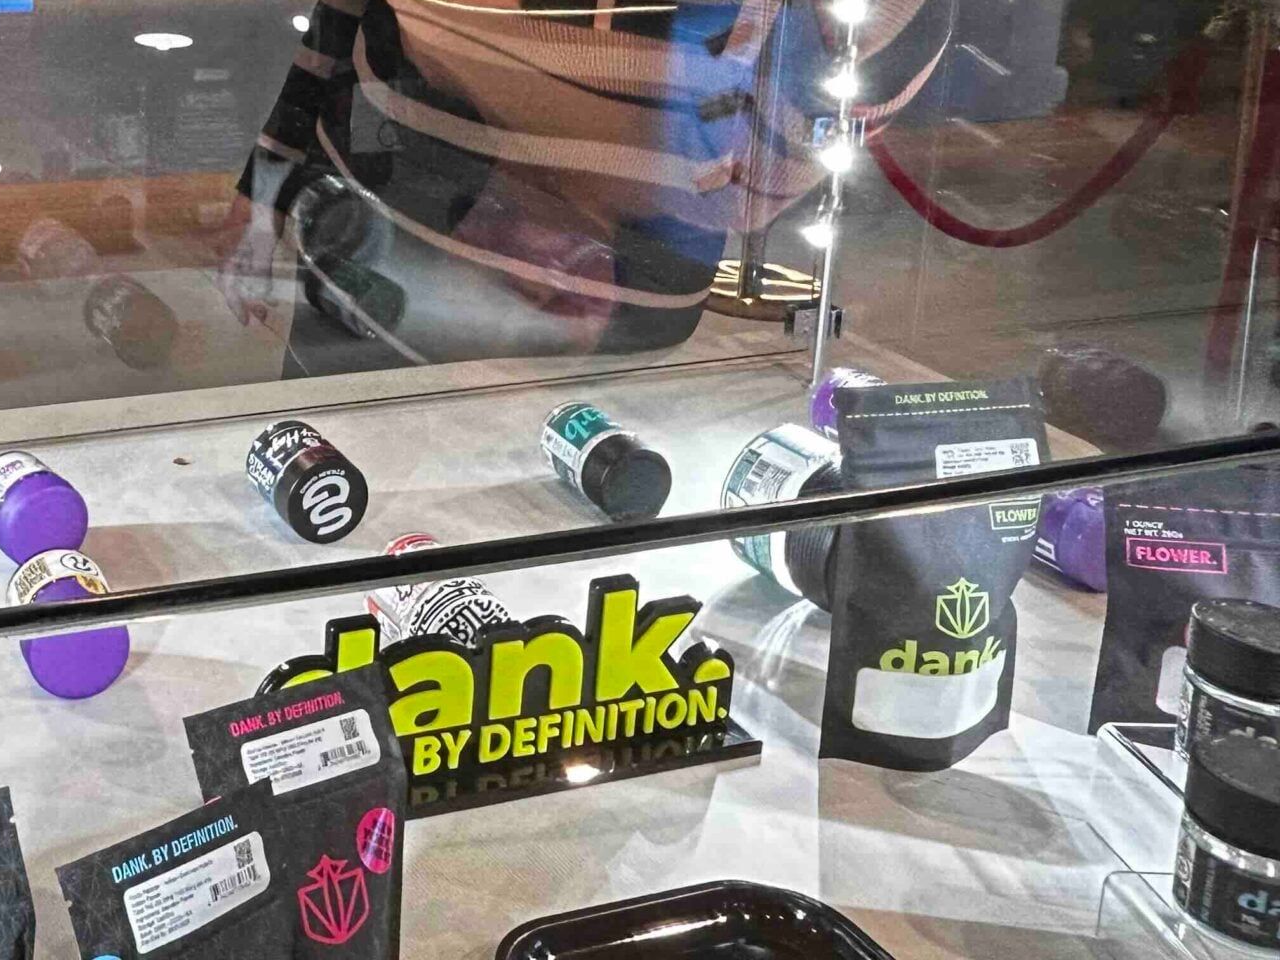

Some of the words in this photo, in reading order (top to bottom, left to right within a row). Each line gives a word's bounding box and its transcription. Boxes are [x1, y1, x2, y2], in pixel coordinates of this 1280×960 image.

[1135, 545, 1218, 565] FLOWER.
[413, 728, 471, 776] BY
[478, 686, 728, 765] DEFINITION.
[111, 853, 153, 884] DANK.
[152, 844, 170, 866] BY
[171, 814, 239, 857] DEFINITION.
